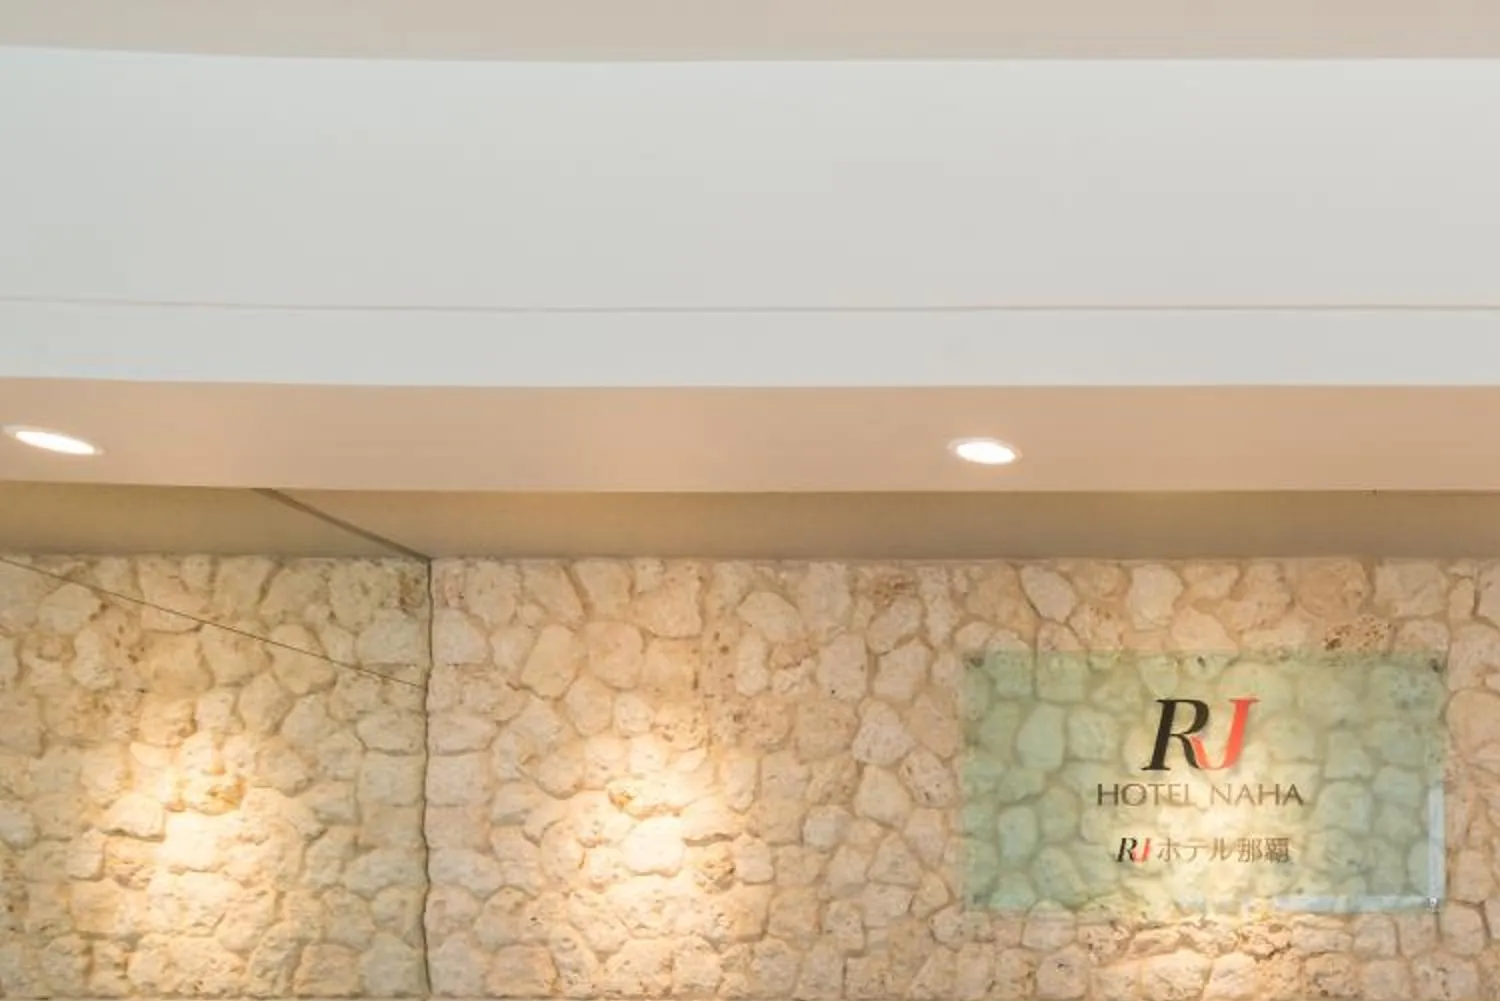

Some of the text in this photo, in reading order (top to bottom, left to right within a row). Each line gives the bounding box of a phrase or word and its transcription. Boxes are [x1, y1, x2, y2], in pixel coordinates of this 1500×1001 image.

[1141, 697, 1260, 771] RJ
[1096, 783, 1304, 806] HOTEL NAHA
